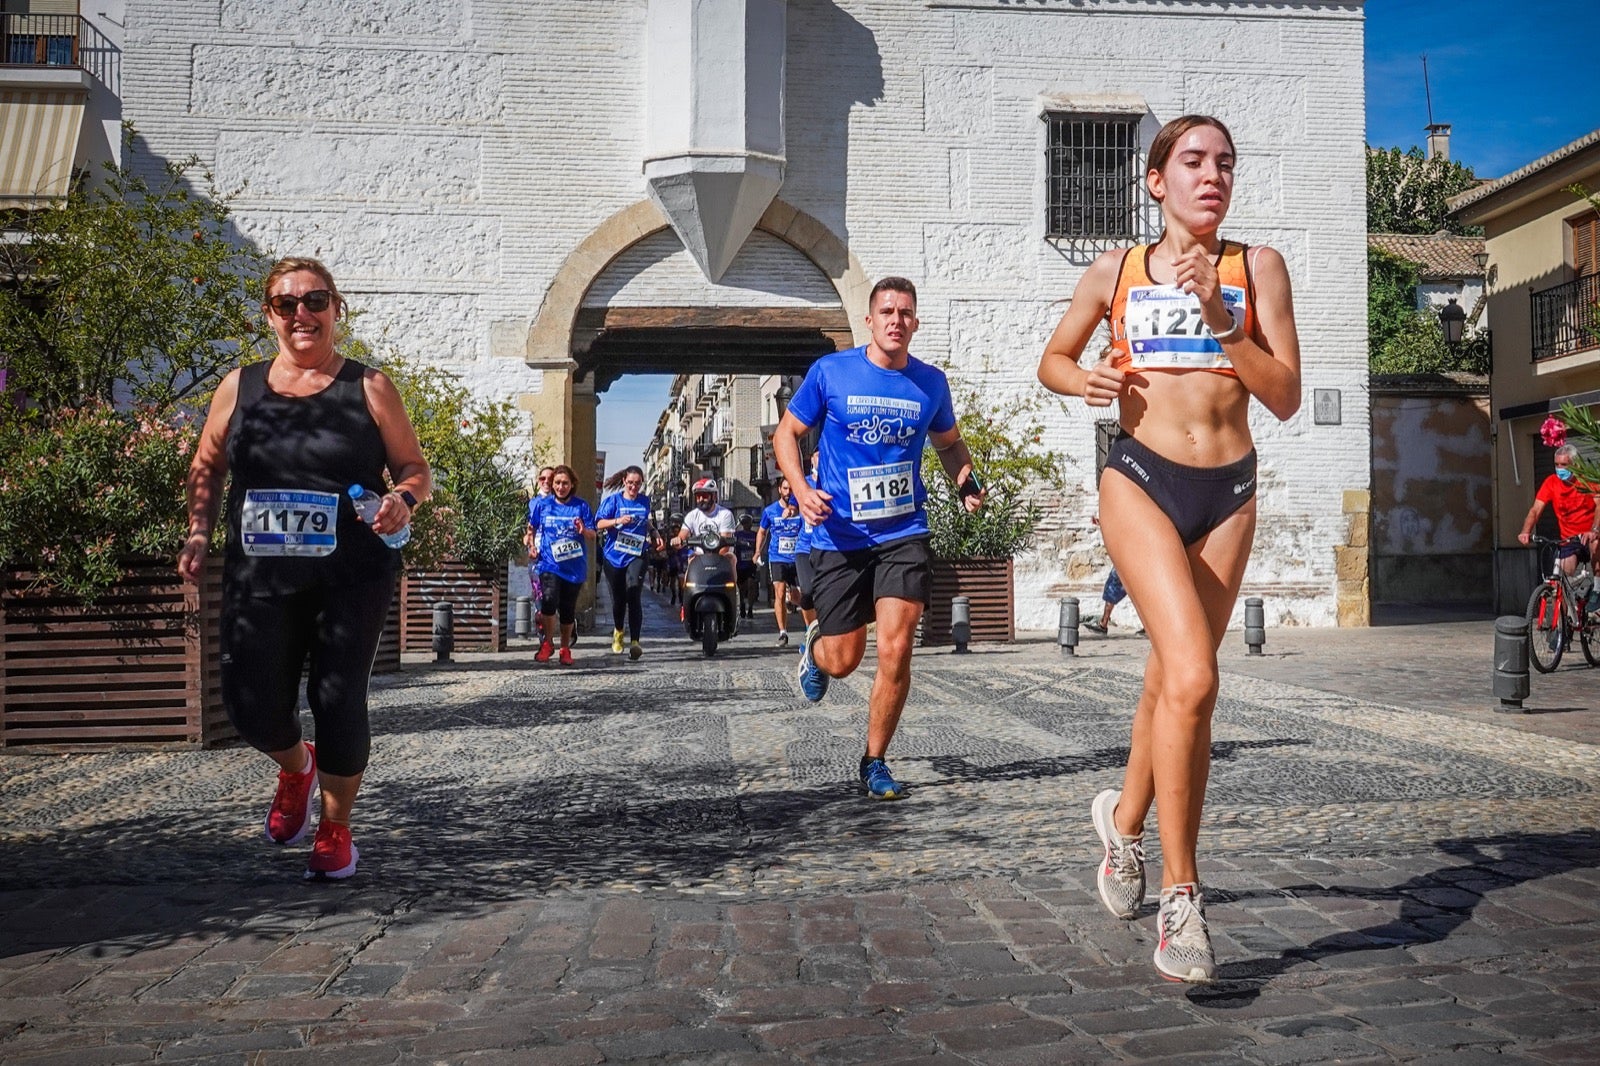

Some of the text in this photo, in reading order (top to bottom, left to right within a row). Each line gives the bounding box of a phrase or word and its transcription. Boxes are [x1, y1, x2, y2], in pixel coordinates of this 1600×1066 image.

[1145, 308, 1234, 335] 127
[862, 477, 910, 500] 1182
[258, 509, 328, 532] 1179
[557, 541, 579, 553] 1258
